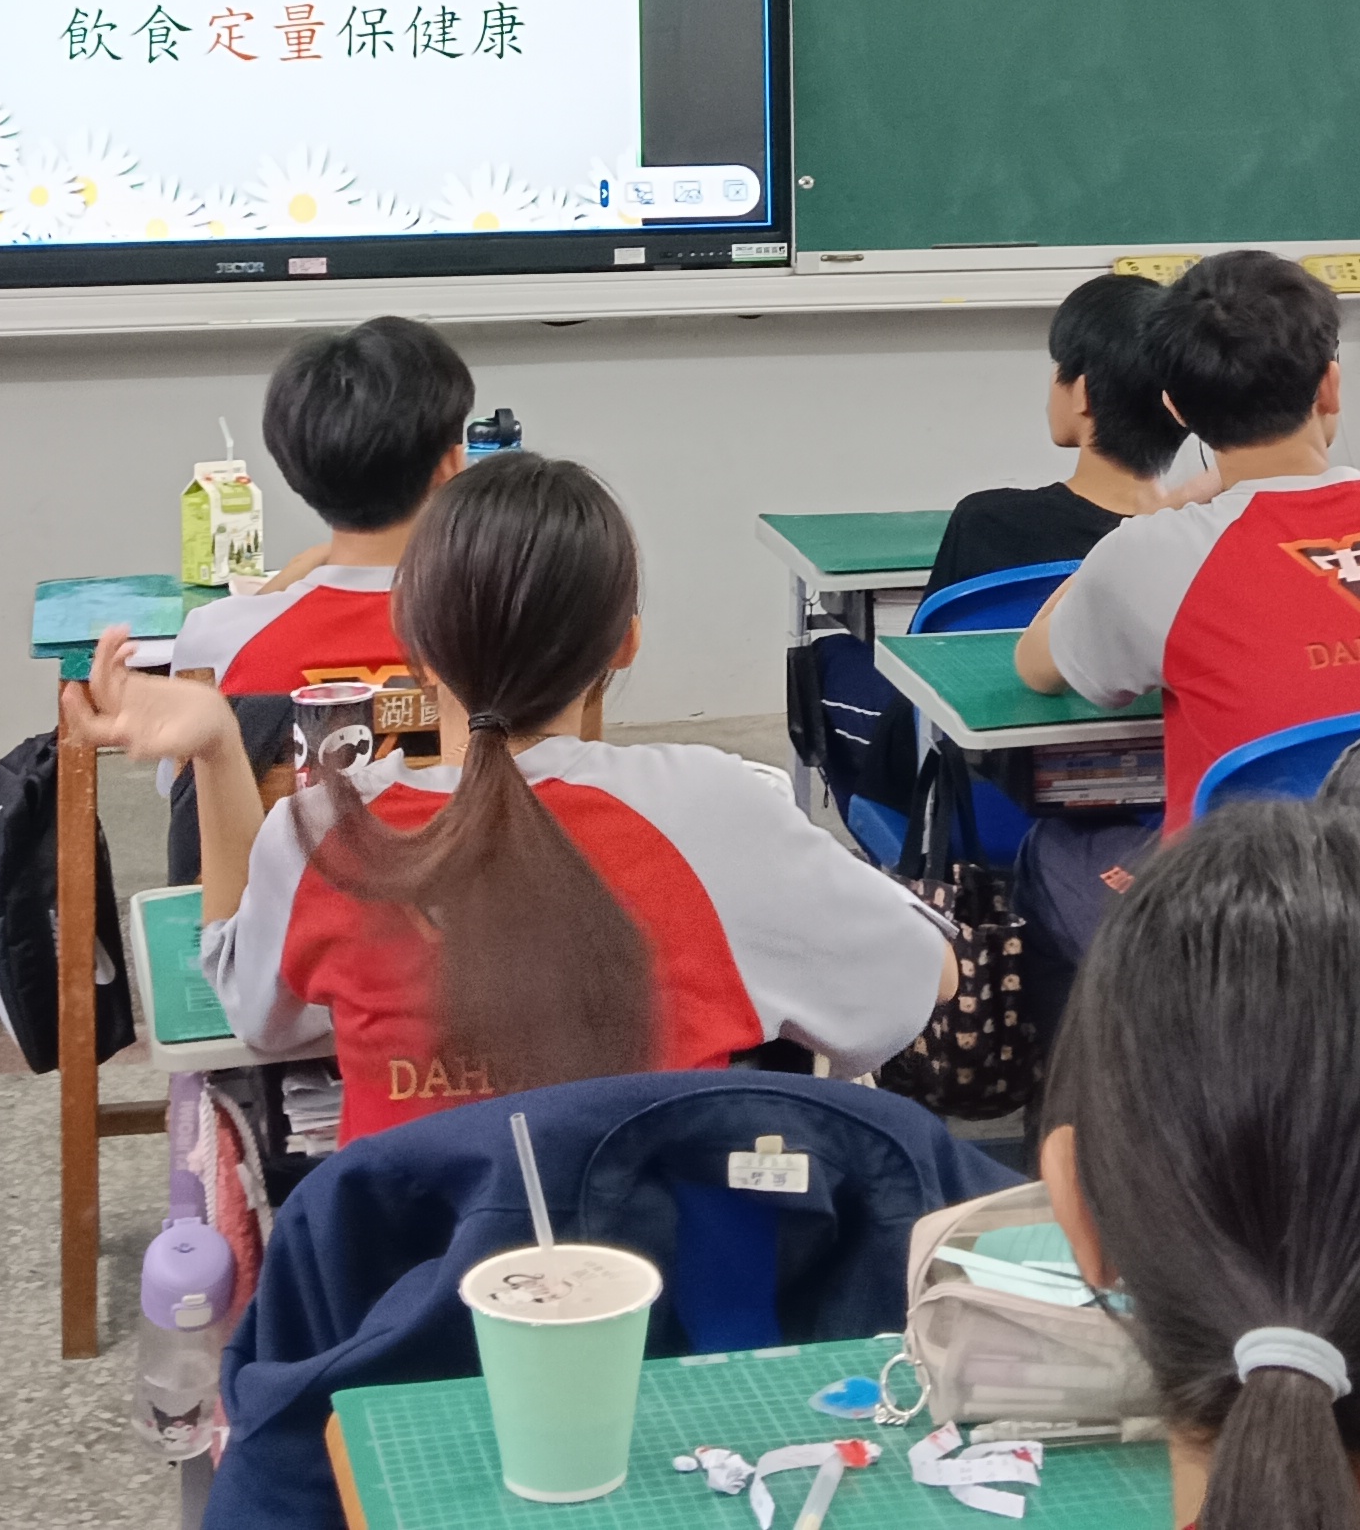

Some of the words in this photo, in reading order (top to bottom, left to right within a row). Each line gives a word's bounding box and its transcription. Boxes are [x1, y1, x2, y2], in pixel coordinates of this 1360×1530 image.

[58, 1, 527, 64] 飲食定量保健康
[388, 1056, 496, 1100] DAH
